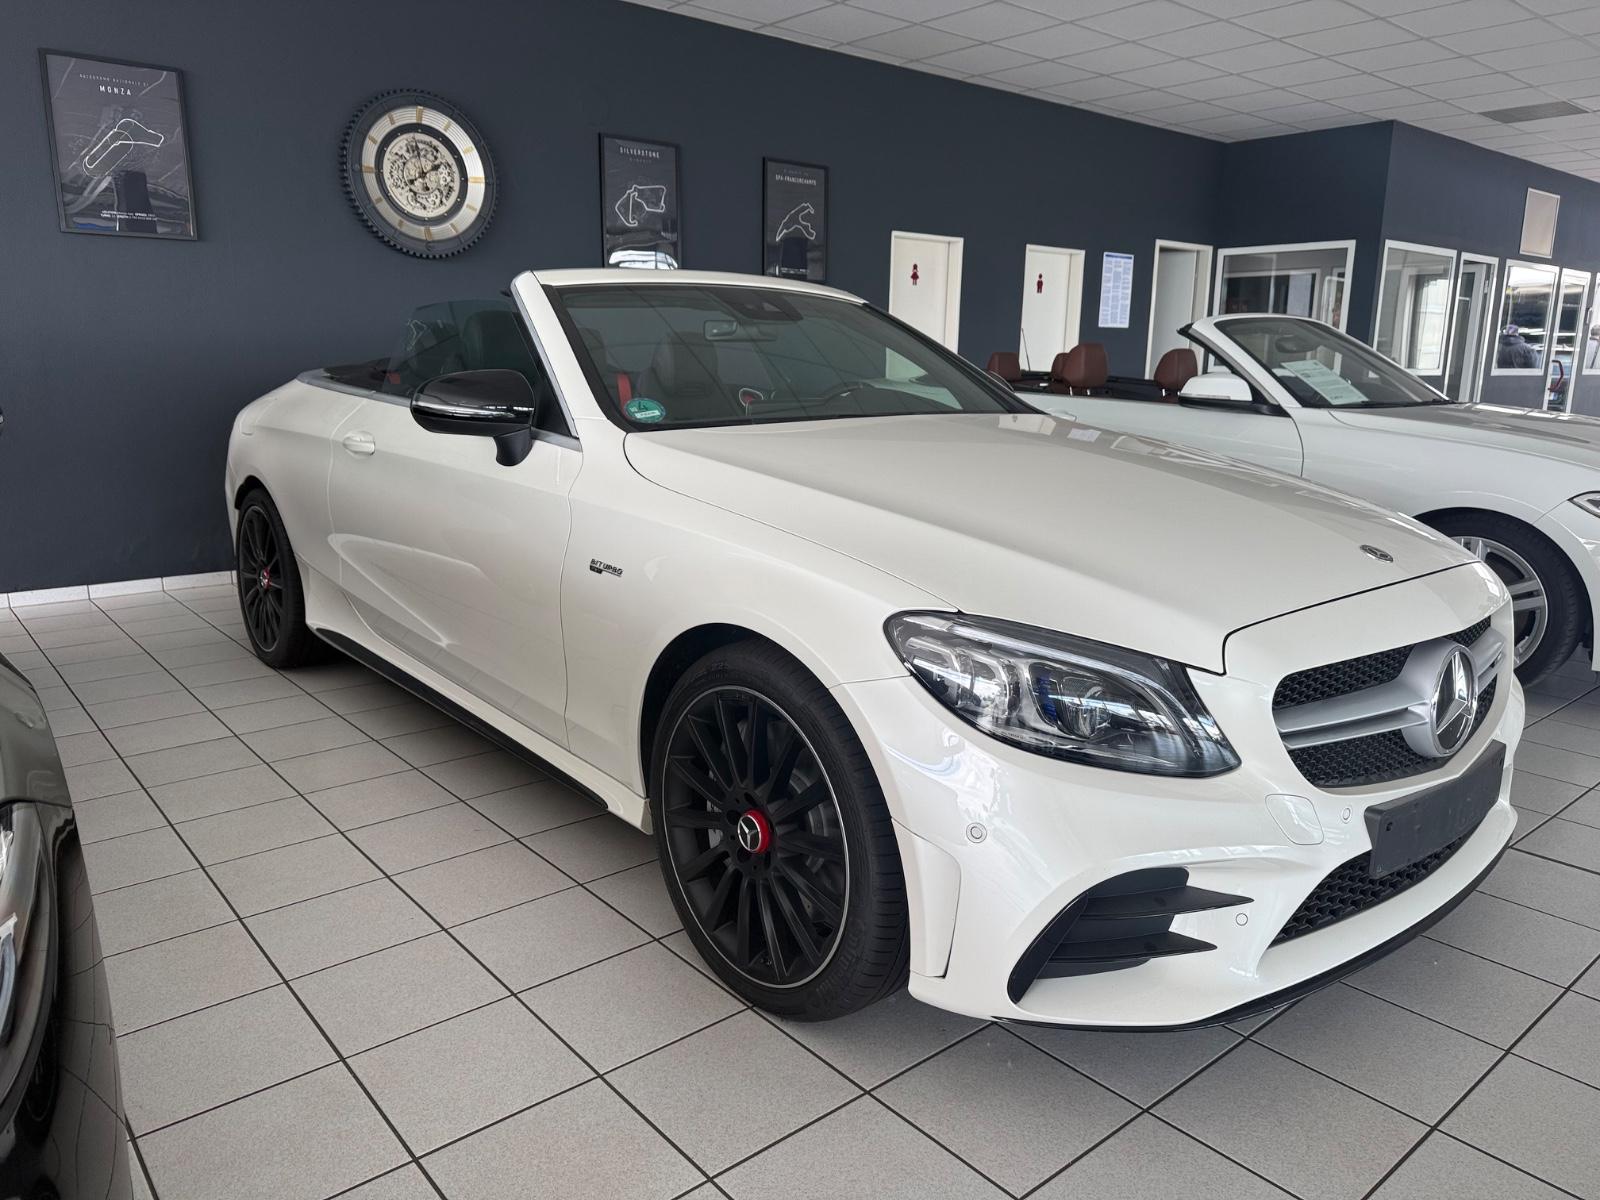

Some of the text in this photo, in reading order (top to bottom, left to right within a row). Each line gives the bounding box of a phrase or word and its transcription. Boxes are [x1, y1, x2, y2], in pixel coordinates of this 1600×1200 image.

[99, 85, 131, 96] MONZA
[619, 146, 660, 159] SILVERSTONE
[590, 558, 623, 575] BITURBO
